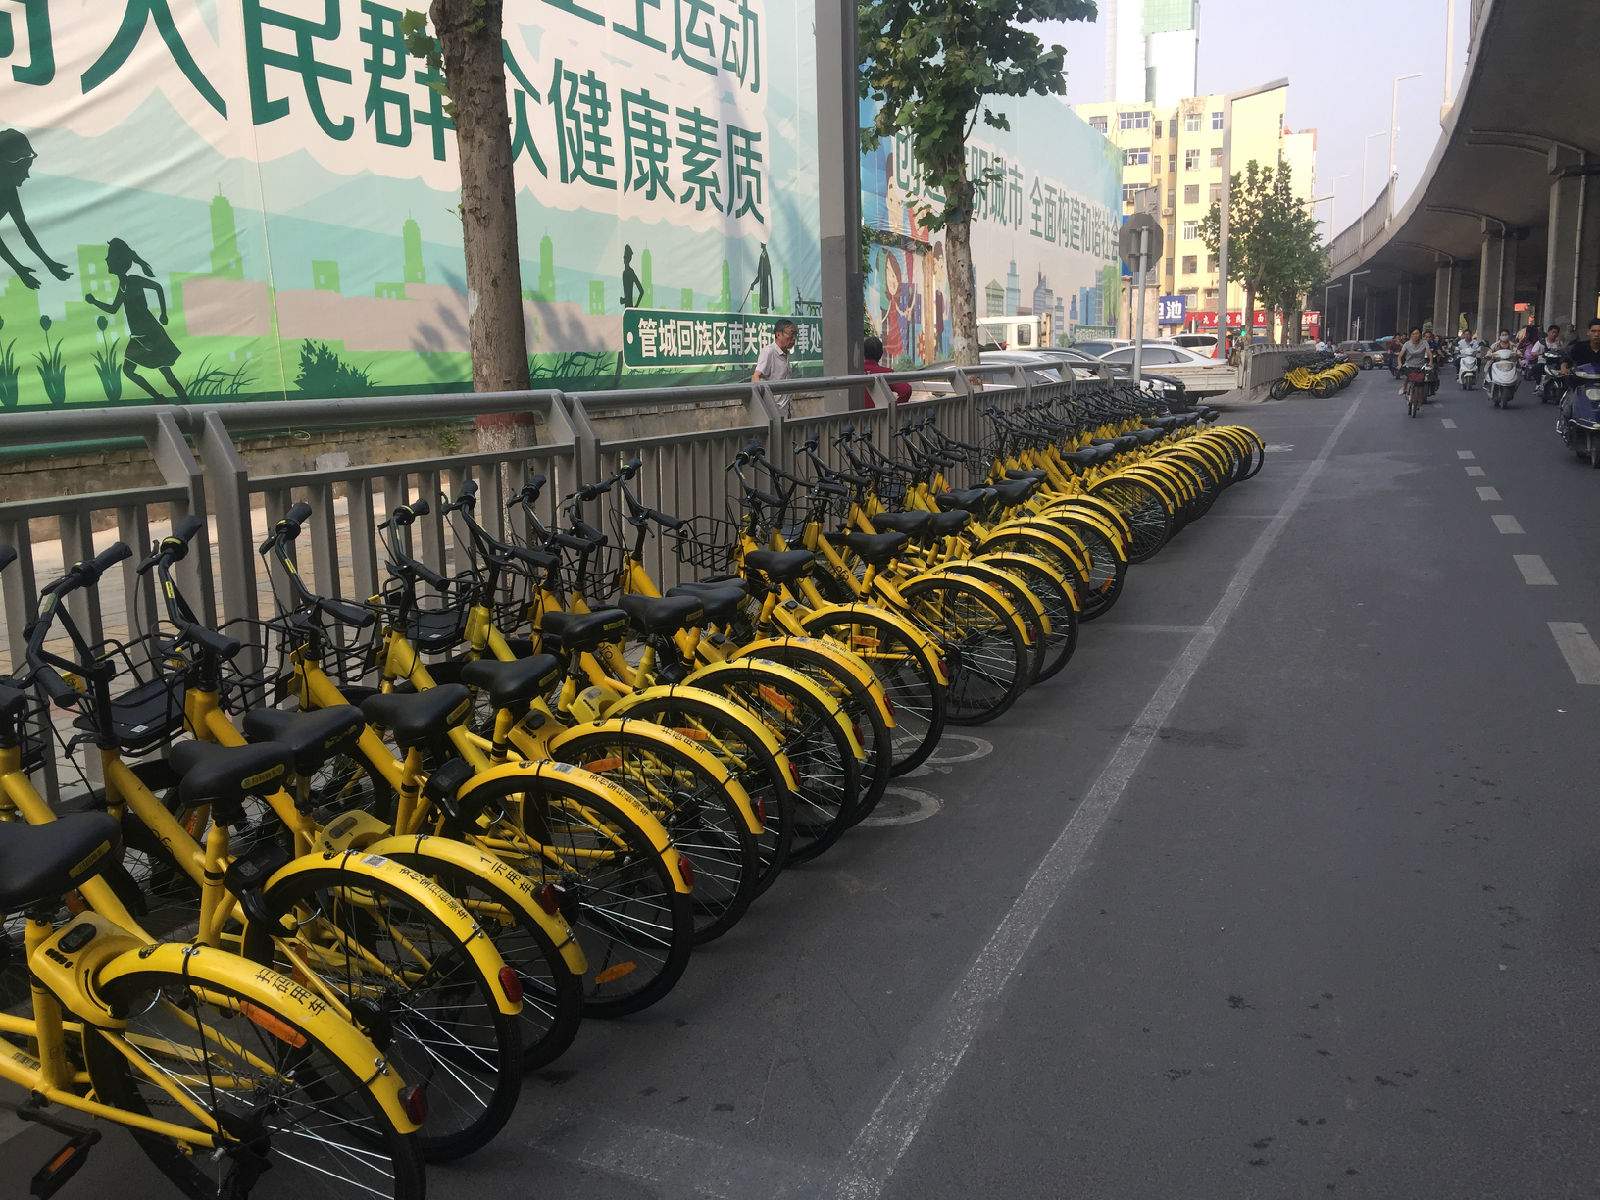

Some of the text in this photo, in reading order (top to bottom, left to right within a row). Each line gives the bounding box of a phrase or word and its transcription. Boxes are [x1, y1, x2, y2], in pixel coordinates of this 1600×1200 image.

[896, 126, 1119, 261] 创明城市 全面构建和谐社会
[638, 317, 822, 359] 管城回族区南关街事处
[256, 968, 326, 1016] 扫码用车
